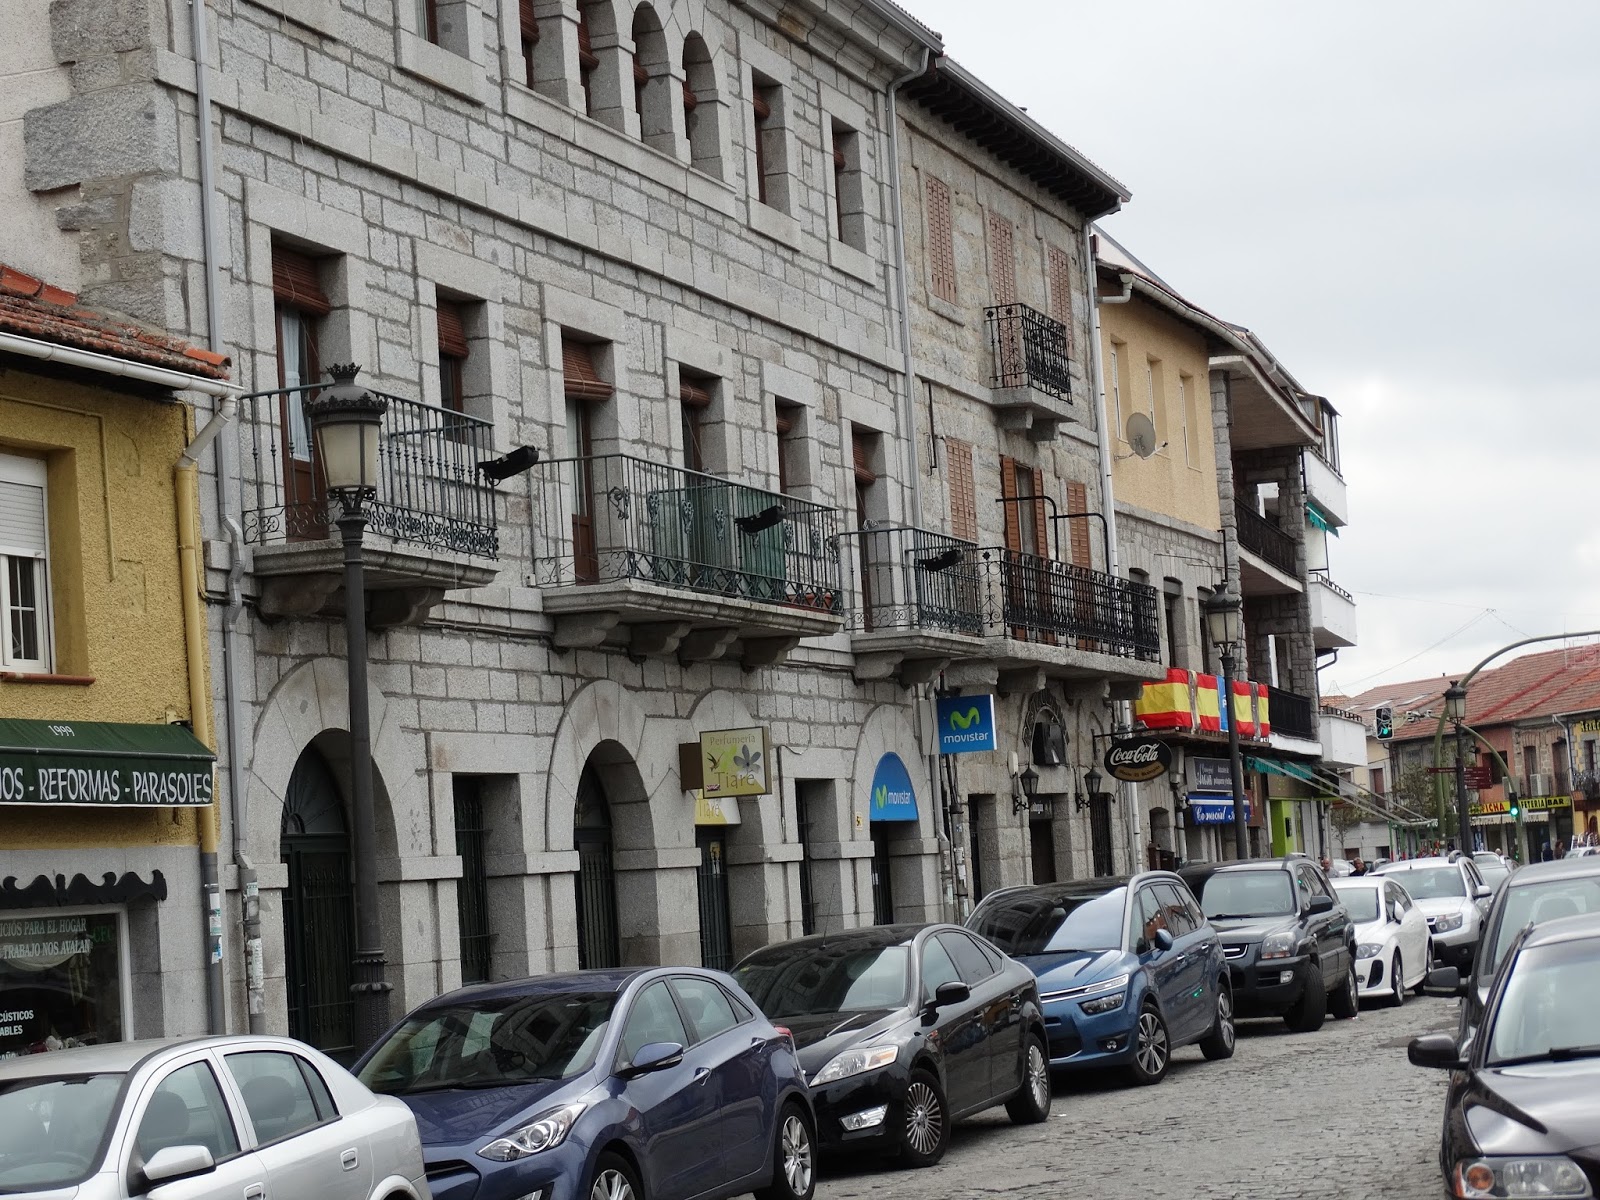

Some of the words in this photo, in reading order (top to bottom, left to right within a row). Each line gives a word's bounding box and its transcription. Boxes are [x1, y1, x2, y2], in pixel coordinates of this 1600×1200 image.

[48, 725, 75, 737] 1999
[944, 732, 989, 744] movistar
[1110, 743, 1160, 766] Coca-Cola
[38, 768, 119, 801] REFORMAS
[133, 771, 212, 803] PARASOLES
[888, 790, 911, 805] movistar
[1521, 799, 1545, 809] FETERIA
[1547, 798, 1564, 806] BAR
[24, 920, 46, 935] PARA
[47, 919, 58, 934] EL
[59, 918, 87, 933] HOGAR
[3, 943, 40, 959] TRABAJO
[42, 941, 59, 956] NOS
[60, 939, 91, 955] AVALAN
[0, 1010, 34, 1022] CÚSTICOS
[0, 1025, 23, 1036] ABLES
